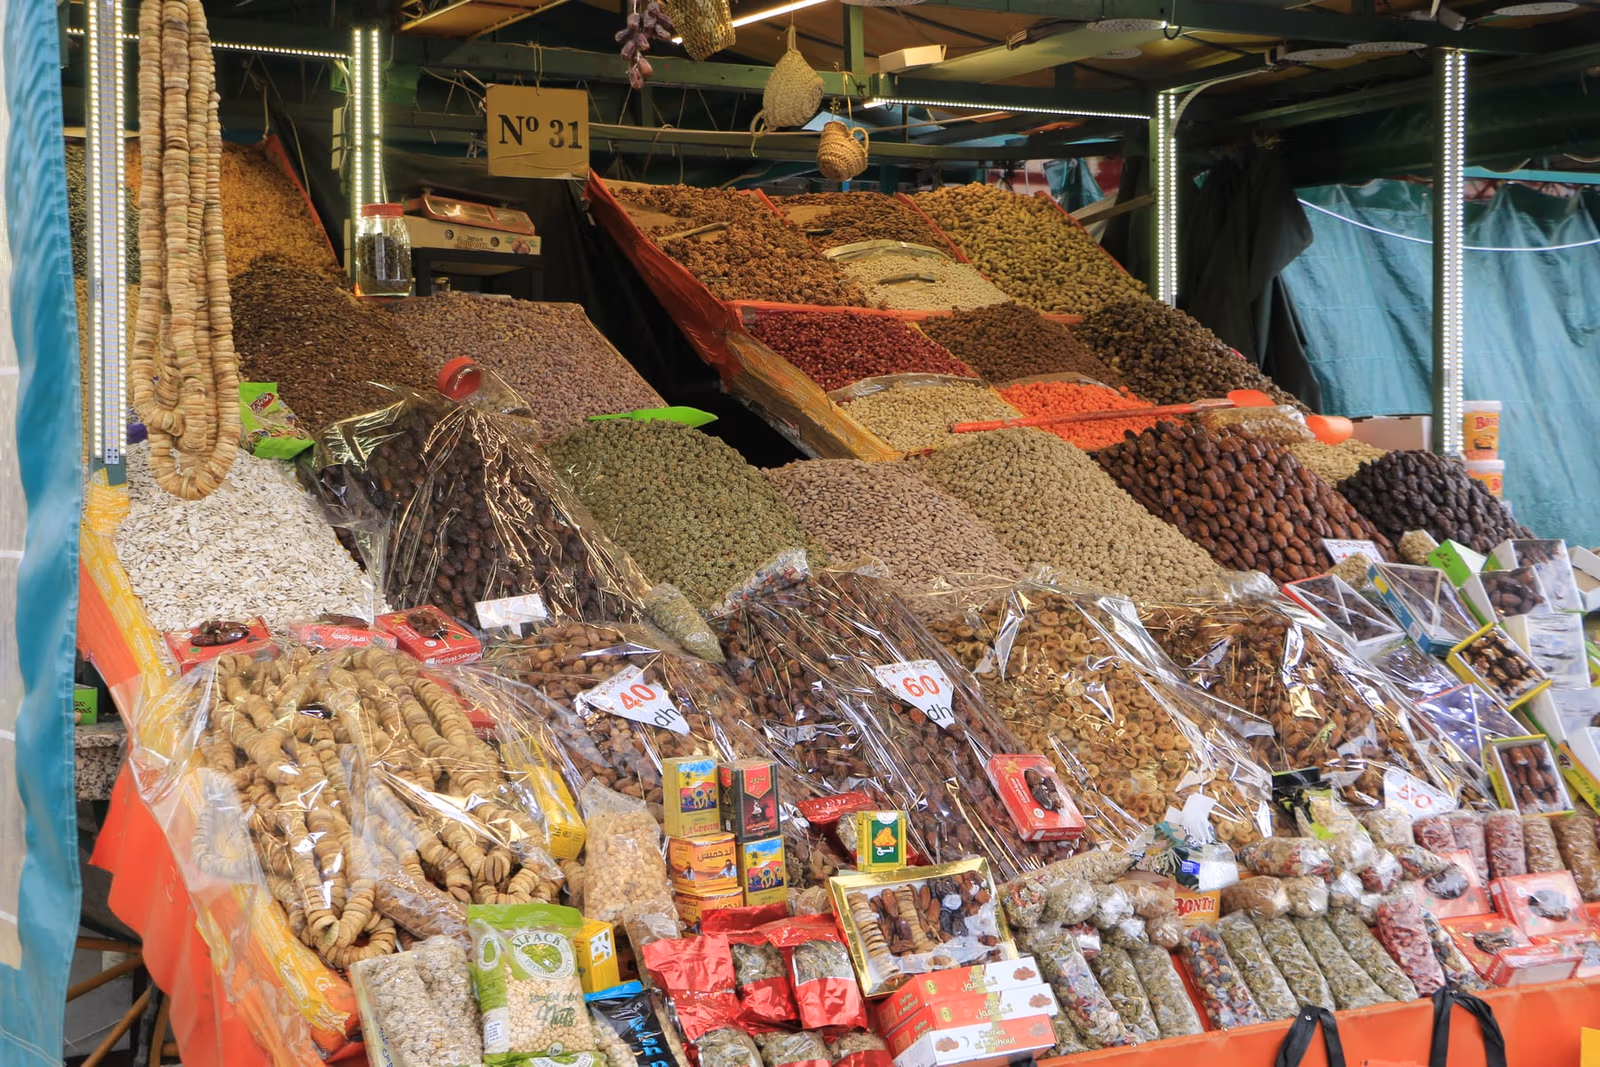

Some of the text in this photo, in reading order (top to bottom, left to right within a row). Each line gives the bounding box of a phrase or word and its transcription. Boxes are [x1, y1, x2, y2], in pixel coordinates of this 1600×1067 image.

[548, 119, 583, 150] 31
[619, 684, 657, 710] 40
[902, 674, 940, 697] 60
[653, 707, 682, 727] dh
[926, 703, 954, 721] dh
[512, 933, 563, 949] ALPACK
[537, 1004, 576, 1028] Nuts
